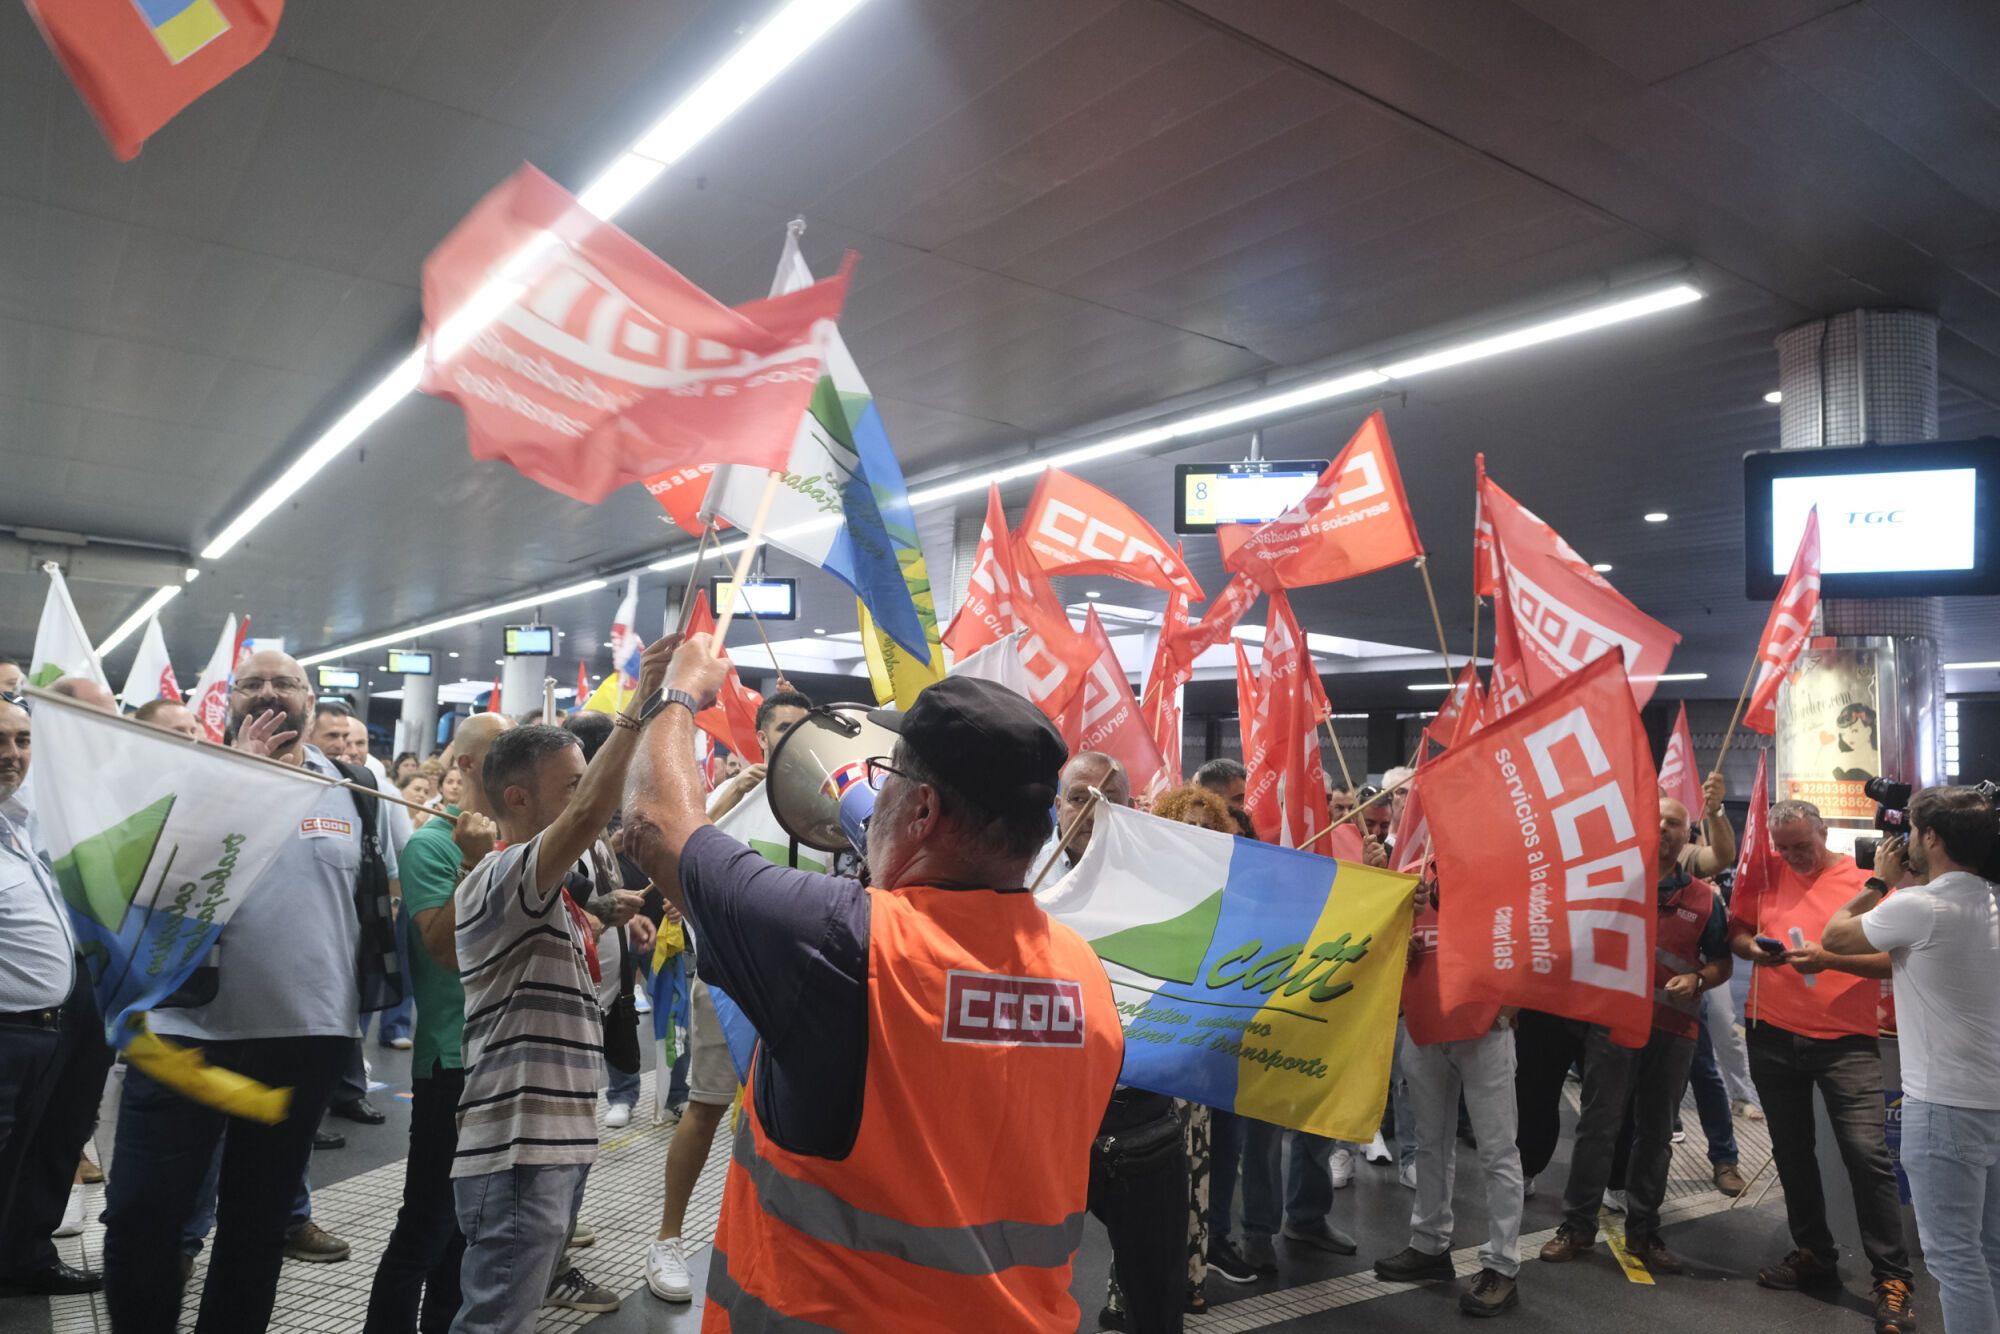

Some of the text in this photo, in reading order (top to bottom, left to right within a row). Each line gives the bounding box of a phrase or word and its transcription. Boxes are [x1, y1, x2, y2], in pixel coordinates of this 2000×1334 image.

[1196, 482, 1207, 500] 8
[1843, 510, 1905, 524] TGC
[1495, 748, 1541, 848] servicios
[1803, 783, 1866, 795] 92803869
[1523, 706, 1647, 998] CCOO
[1527, 851, 1544, 864] a
[1529, 863, 1551, 883] la
[1206, 933, 1372, 1001] catt
[959, 988, 1077, 1032] CCOO
[1208, 1034, 1329, 1079] transporte
